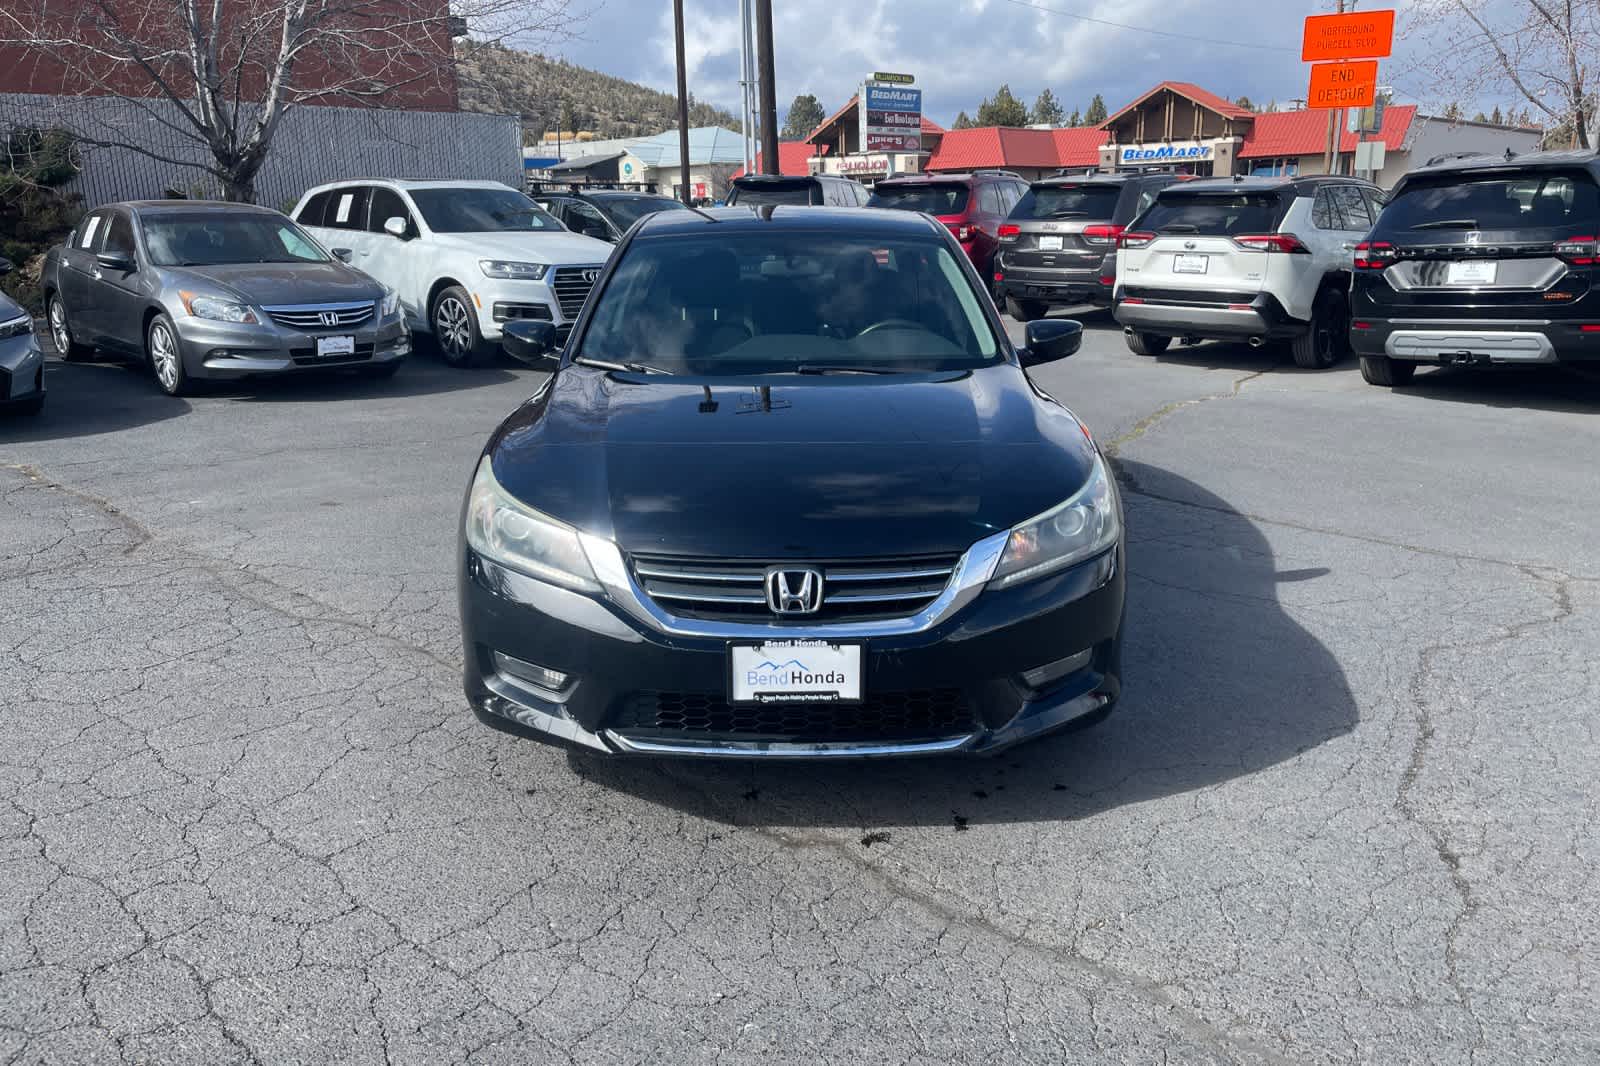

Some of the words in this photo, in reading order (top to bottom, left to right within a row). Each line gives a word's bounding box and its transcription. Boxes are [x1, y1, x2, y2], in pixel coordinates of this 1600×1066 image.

[1321, 24, 1375, 36] NORTHBOUND
[1317, 39, 1352, 49] PURCELL
[1355, 38, 1376, 48] BLVD
[1331, 69, 1355, 82] END
[1318, 87, 1366, 102] DETOUR
[764, 640, 792, 648] Bend
[794, 640, 828, 648] Honda
[747, 671, 788, 686] Bend
[791, 670, 845, 685] Honda
